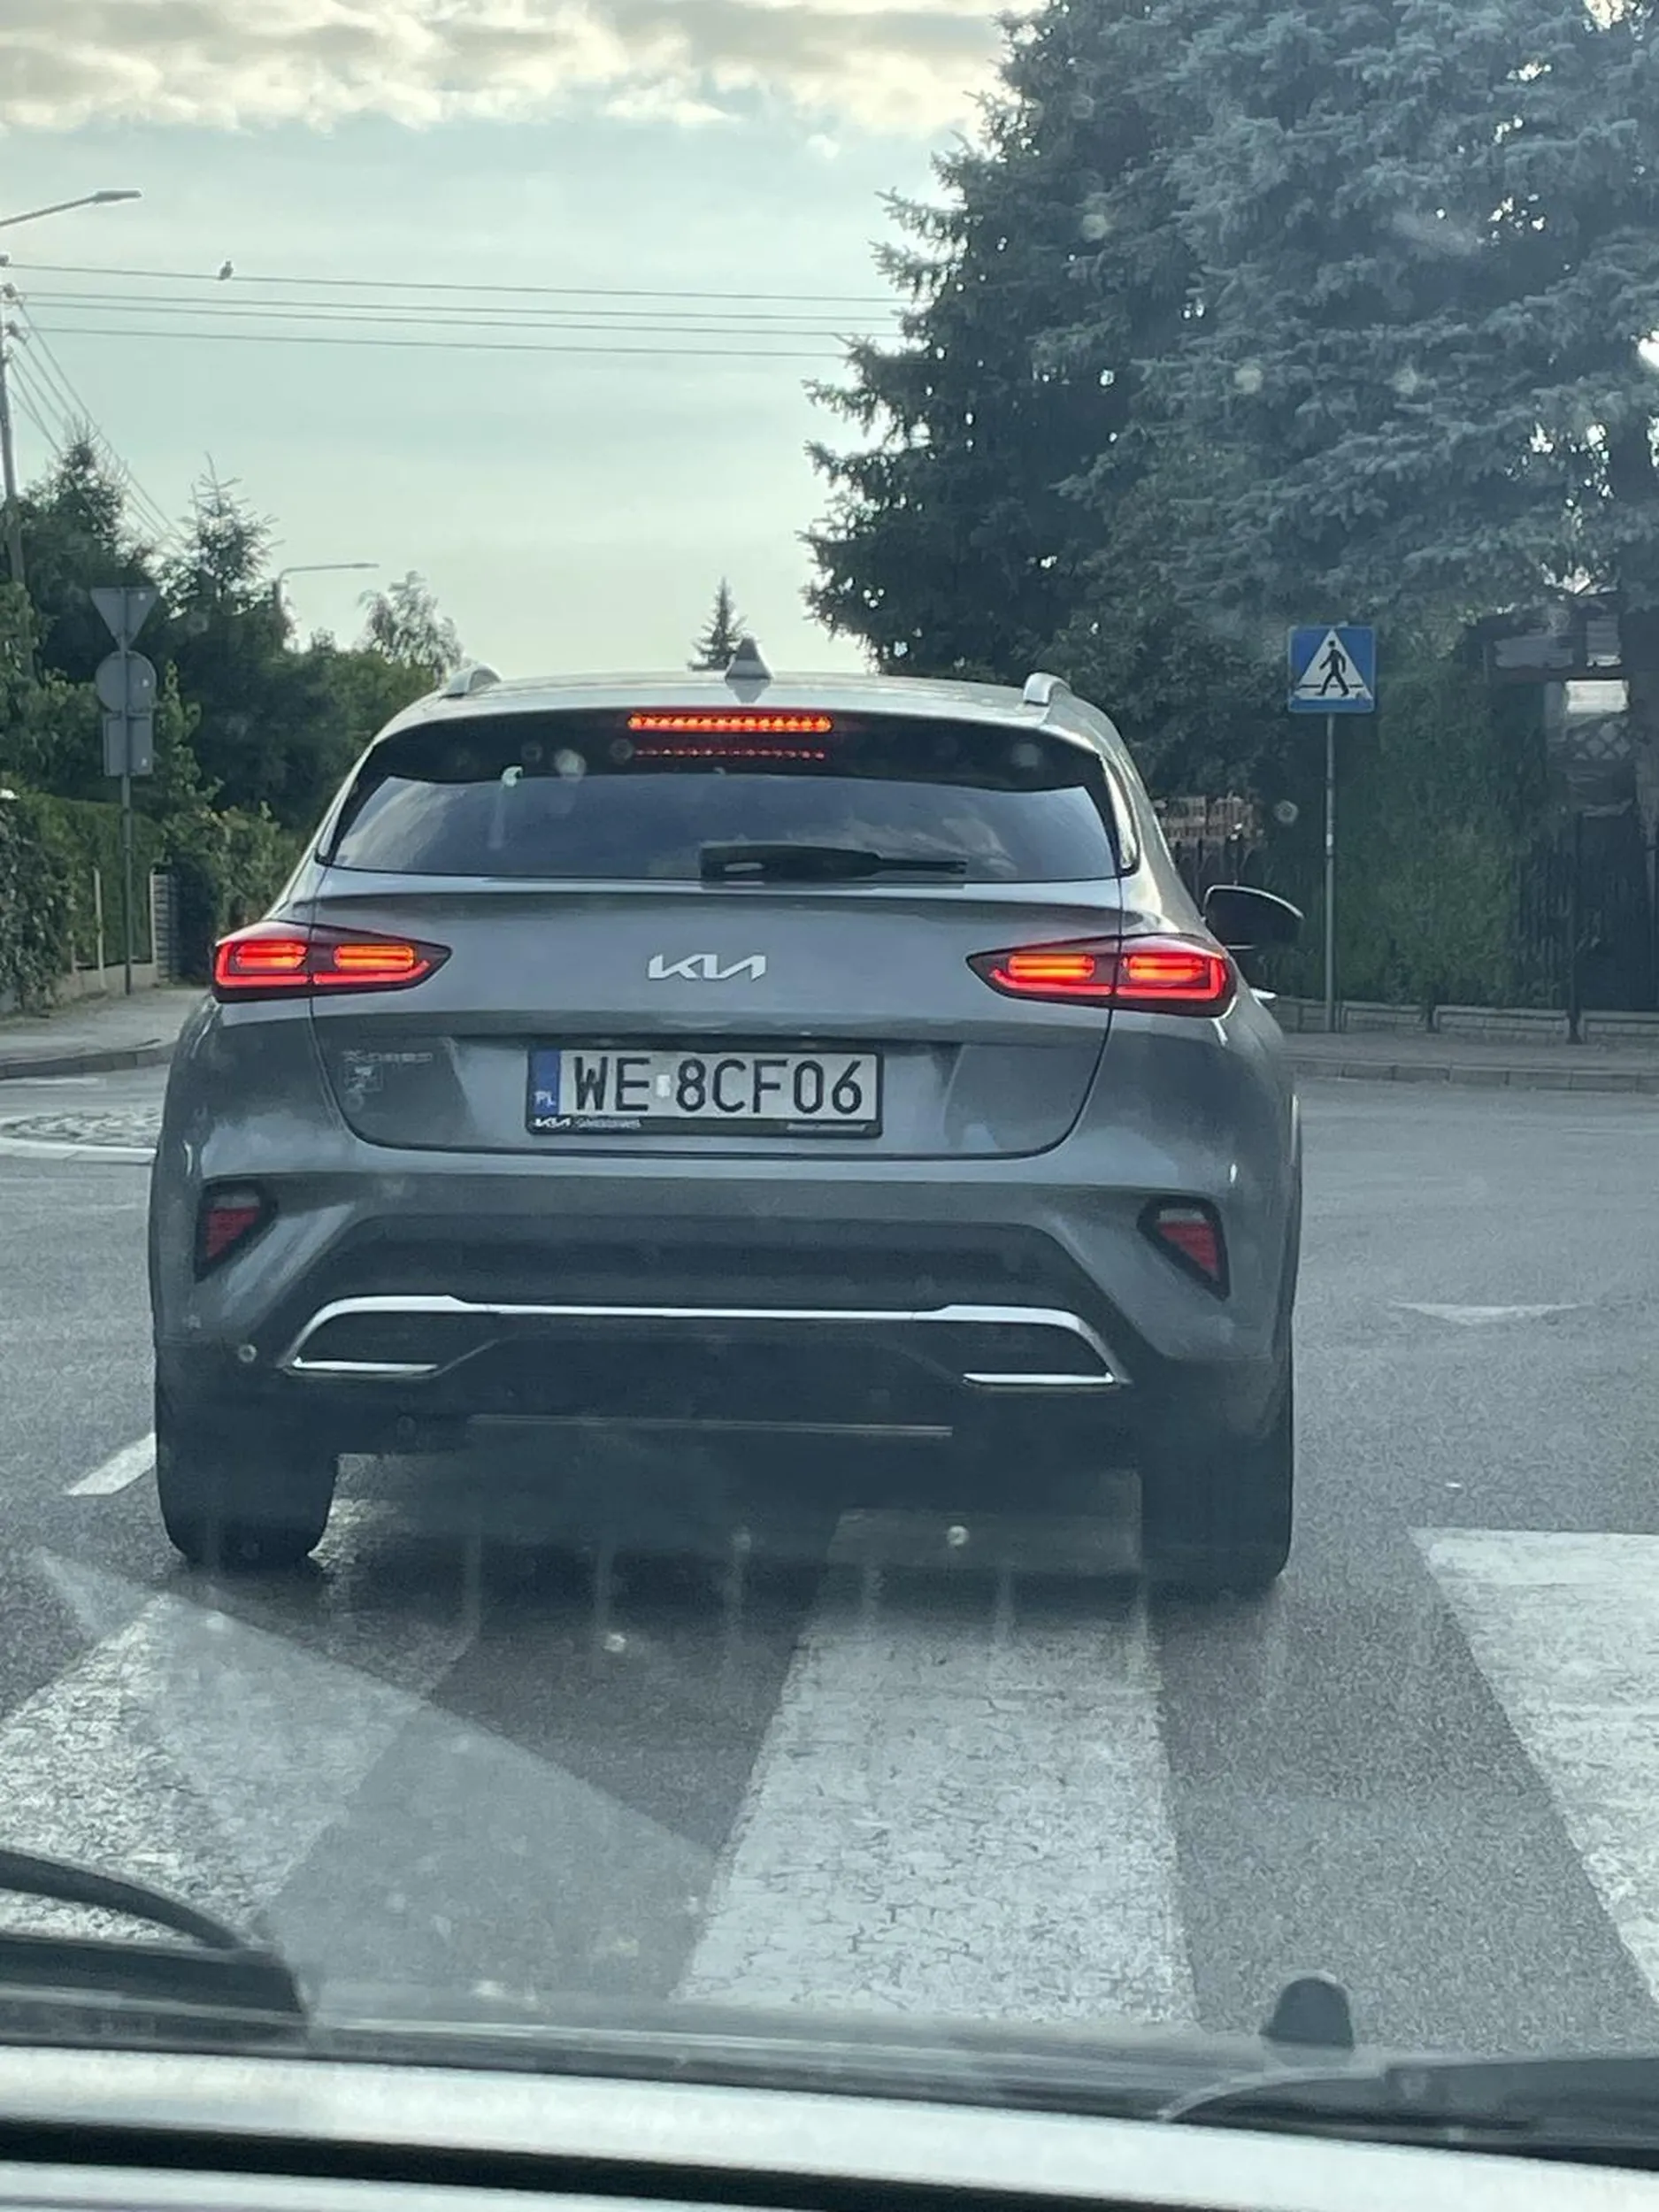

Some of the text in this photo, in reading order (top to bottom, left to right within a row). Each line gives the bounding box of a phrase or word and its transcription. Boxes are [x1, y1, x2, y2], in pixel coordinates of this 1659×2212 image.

[649, 954, 766, 979] KIA
[573, 1056, 864, 1116] WE 8CF06
[534, 1091, 556, 1107] PL
